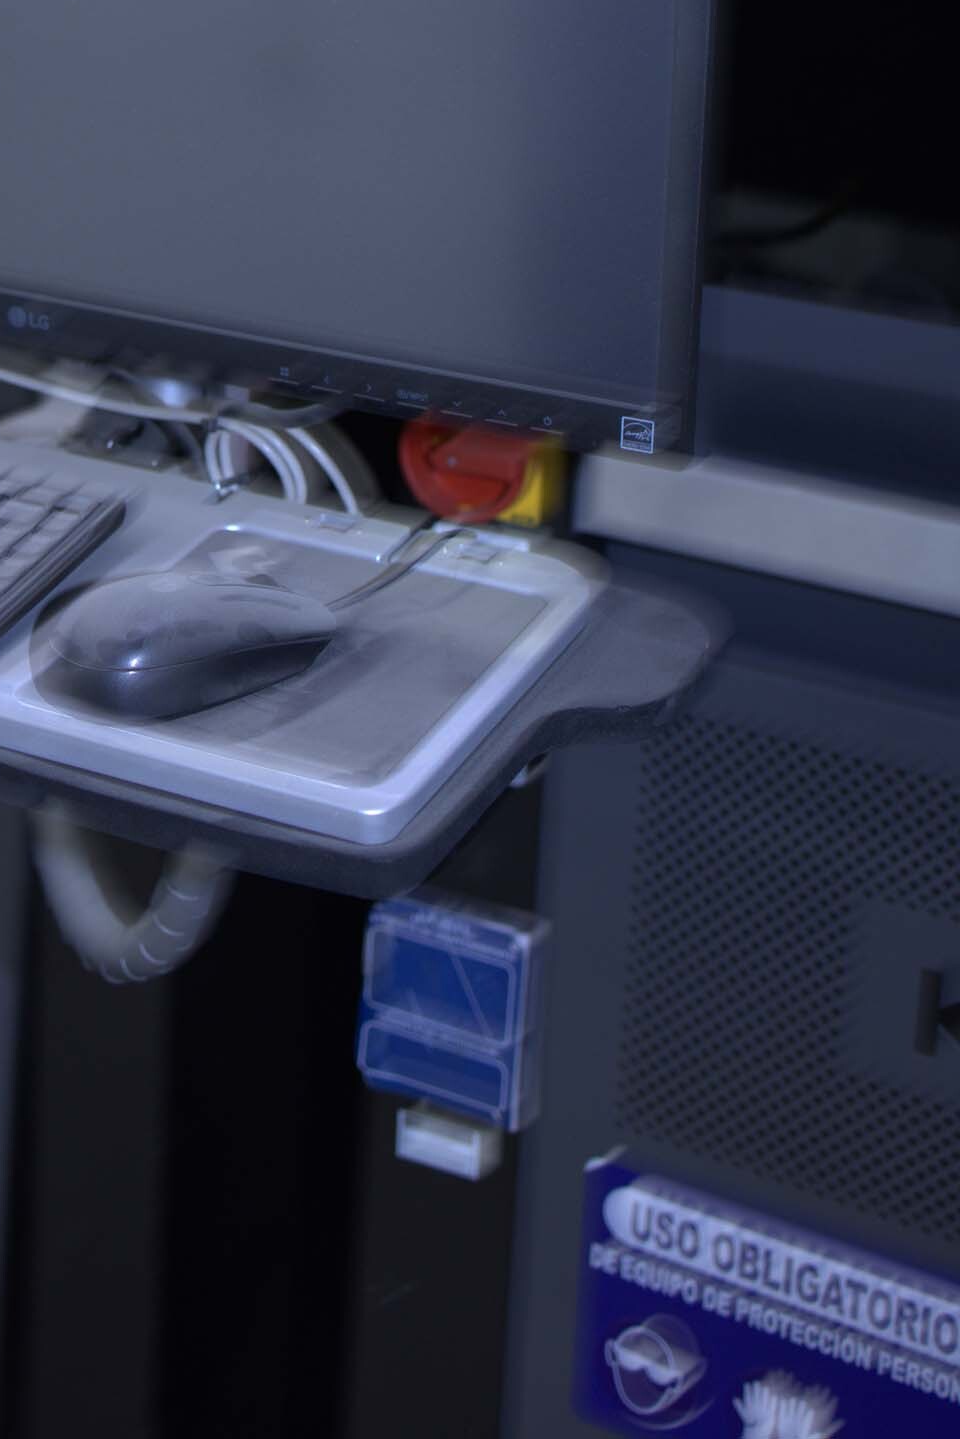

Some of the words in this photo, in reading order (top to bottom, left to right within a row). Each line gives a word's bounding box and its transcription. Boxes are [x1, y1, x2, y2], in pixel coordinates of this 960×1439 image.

[589, 1242, 619, 1276] DE
[619, 1252, 699, 1305] EQUIPO
[702, 1284, 732, 1318] DE
[631, 1199, 700, 1260] USO
[712, 1233, 959, 1356] OBLIGATORIO
